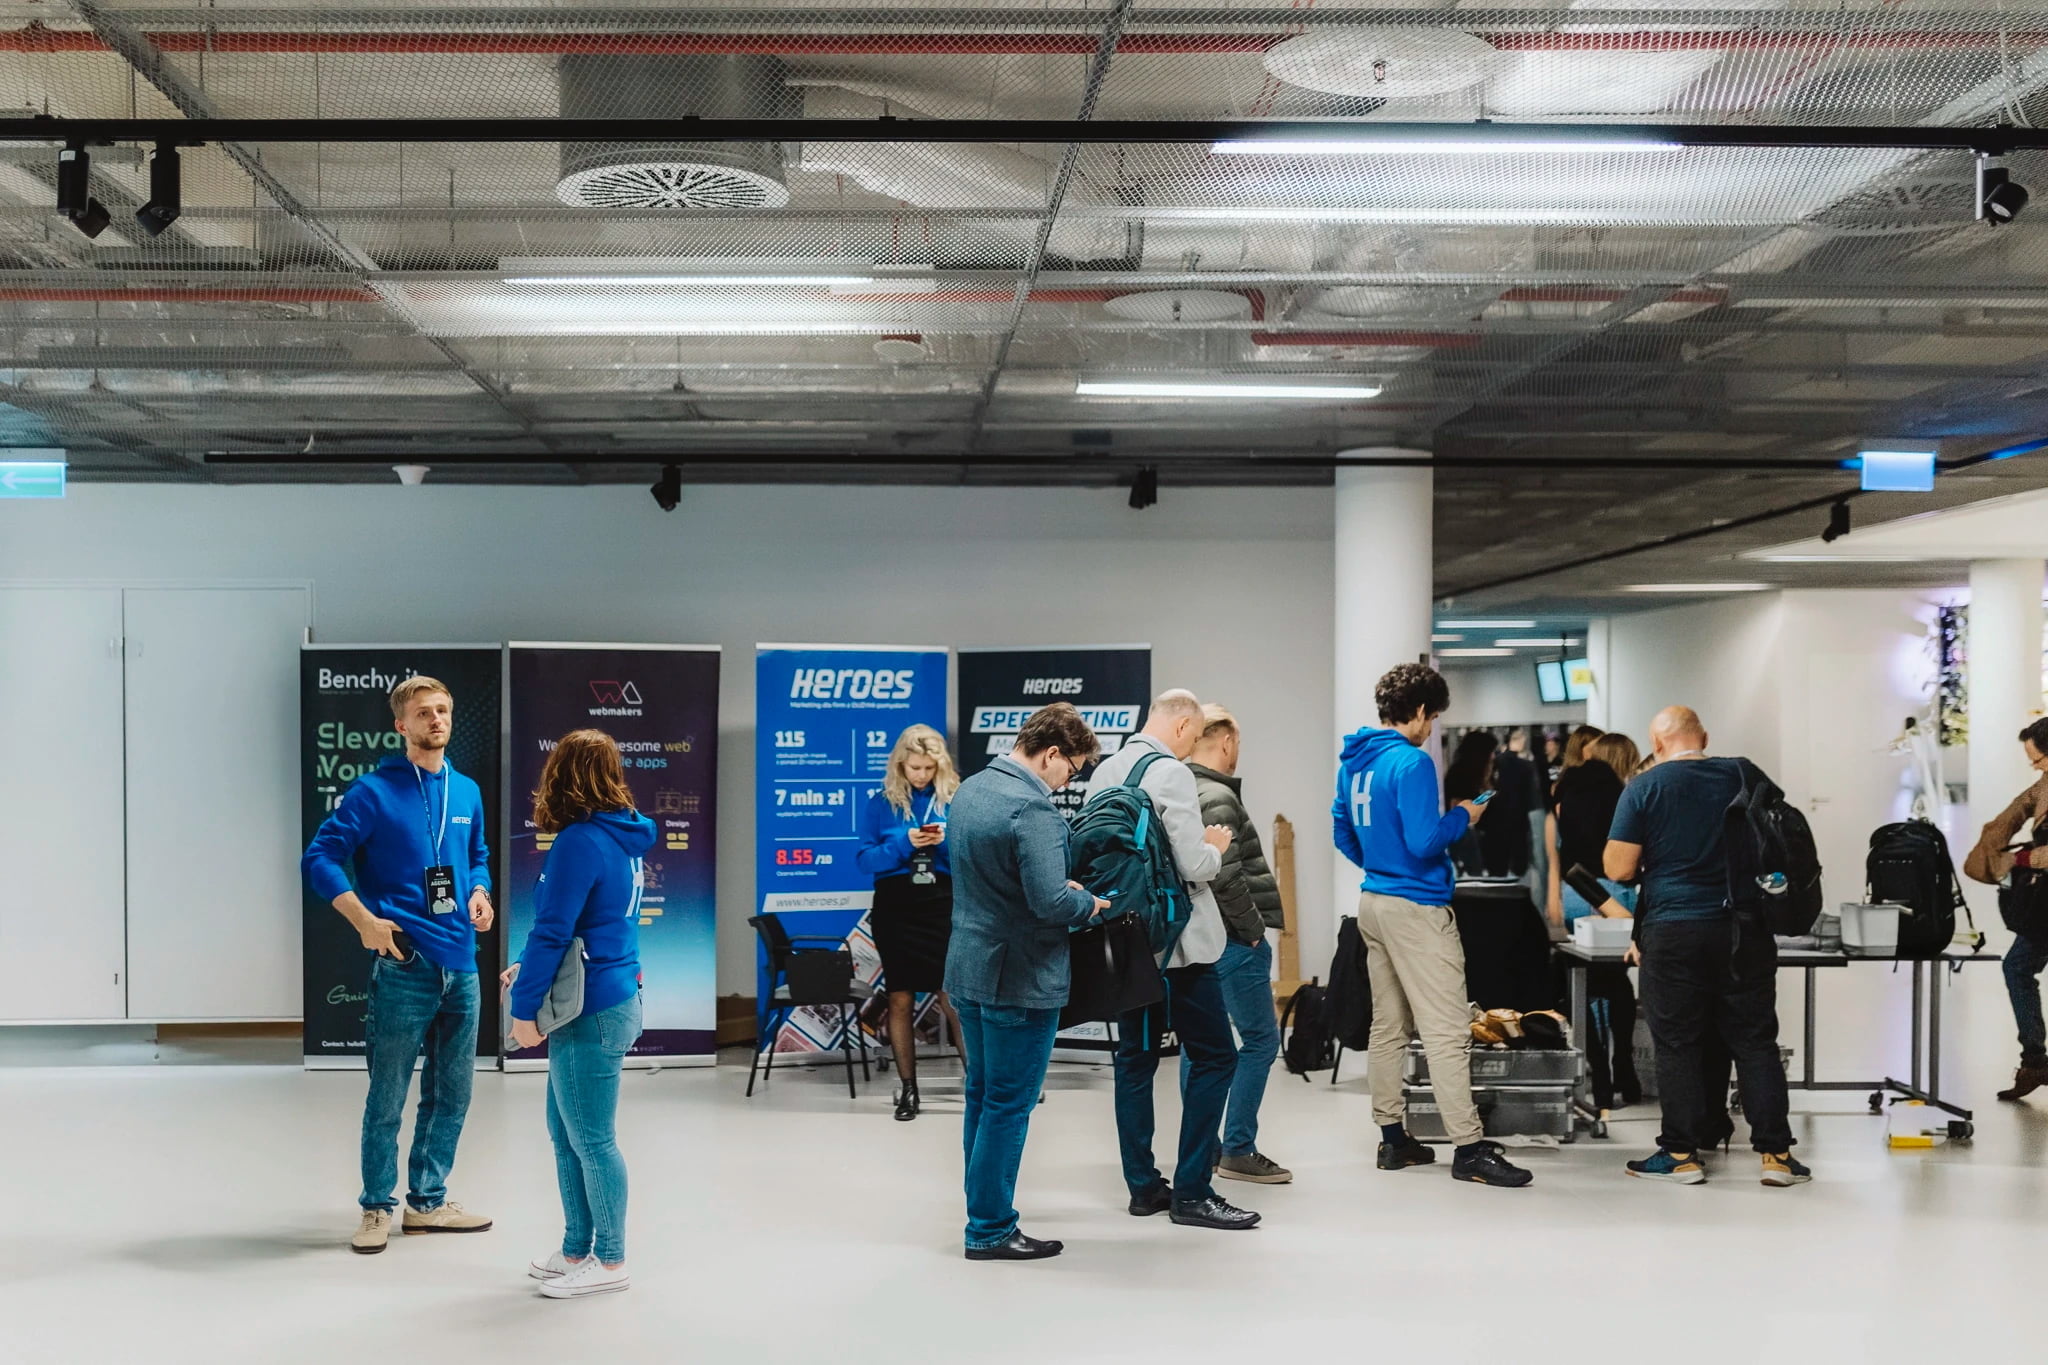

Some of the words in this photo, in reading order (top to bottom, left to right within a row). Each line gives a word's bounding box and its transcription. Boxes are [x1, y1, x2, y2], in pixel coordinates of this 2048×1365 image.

[319, 667, 397, 694] Benchy
[588, 707, 642, 716] webmakers
[979, 711, 1029, 728] SPEE
[1083, 711, 1129, 728] TING
[317, 722, 401, 749] Eleva
[775, 731, 805, 748] 115
[866, 731, 887, 748] 12
[615, 741, 661, 752] esome
[664, 740, 691, 752] web
[636, 757, 668, 770] apps
[775, 789, 787, 806] 7
[790, 789, 824, 805] mln
[827, 789, 845, 805] zł
[1351, 771, 1375, 826] H
[665, 820, 690, 828] Design
[776, 849, 813, 865] 8.55
